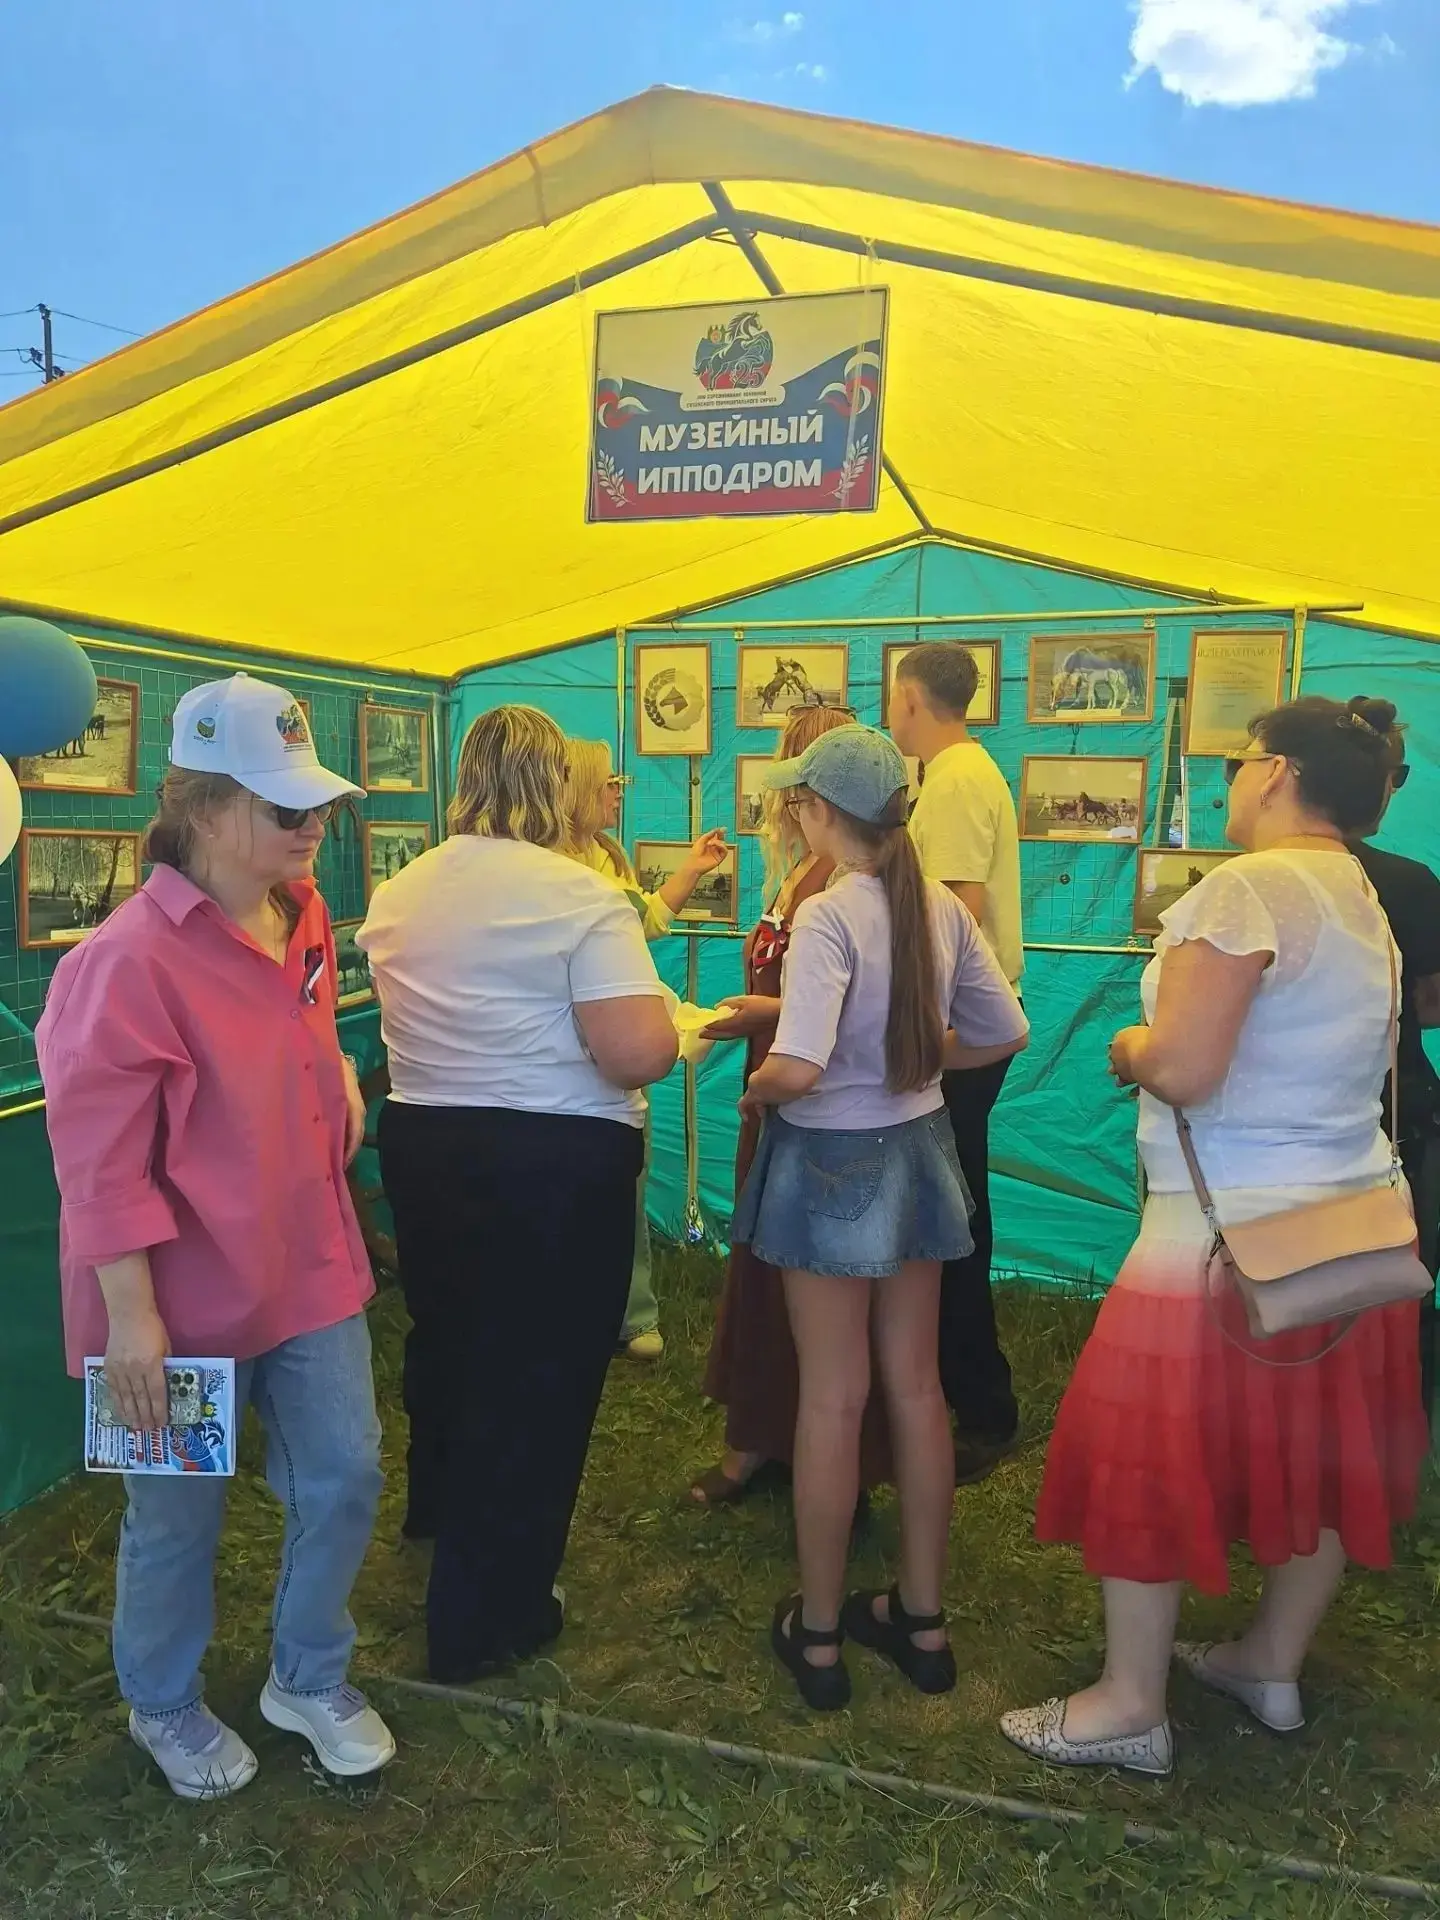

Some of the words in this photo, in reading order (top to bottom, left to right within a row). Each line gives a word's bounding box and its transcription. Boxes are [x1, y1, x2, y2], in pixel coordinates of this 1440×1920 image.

[735, 361, 765, 389] 25
[639, 409, 824, 452] МУЗЕЙНЫЙ
[637, 459, 822, 495] ИППОДРОМ
[127, 1437, 136, 1460] 11:00
